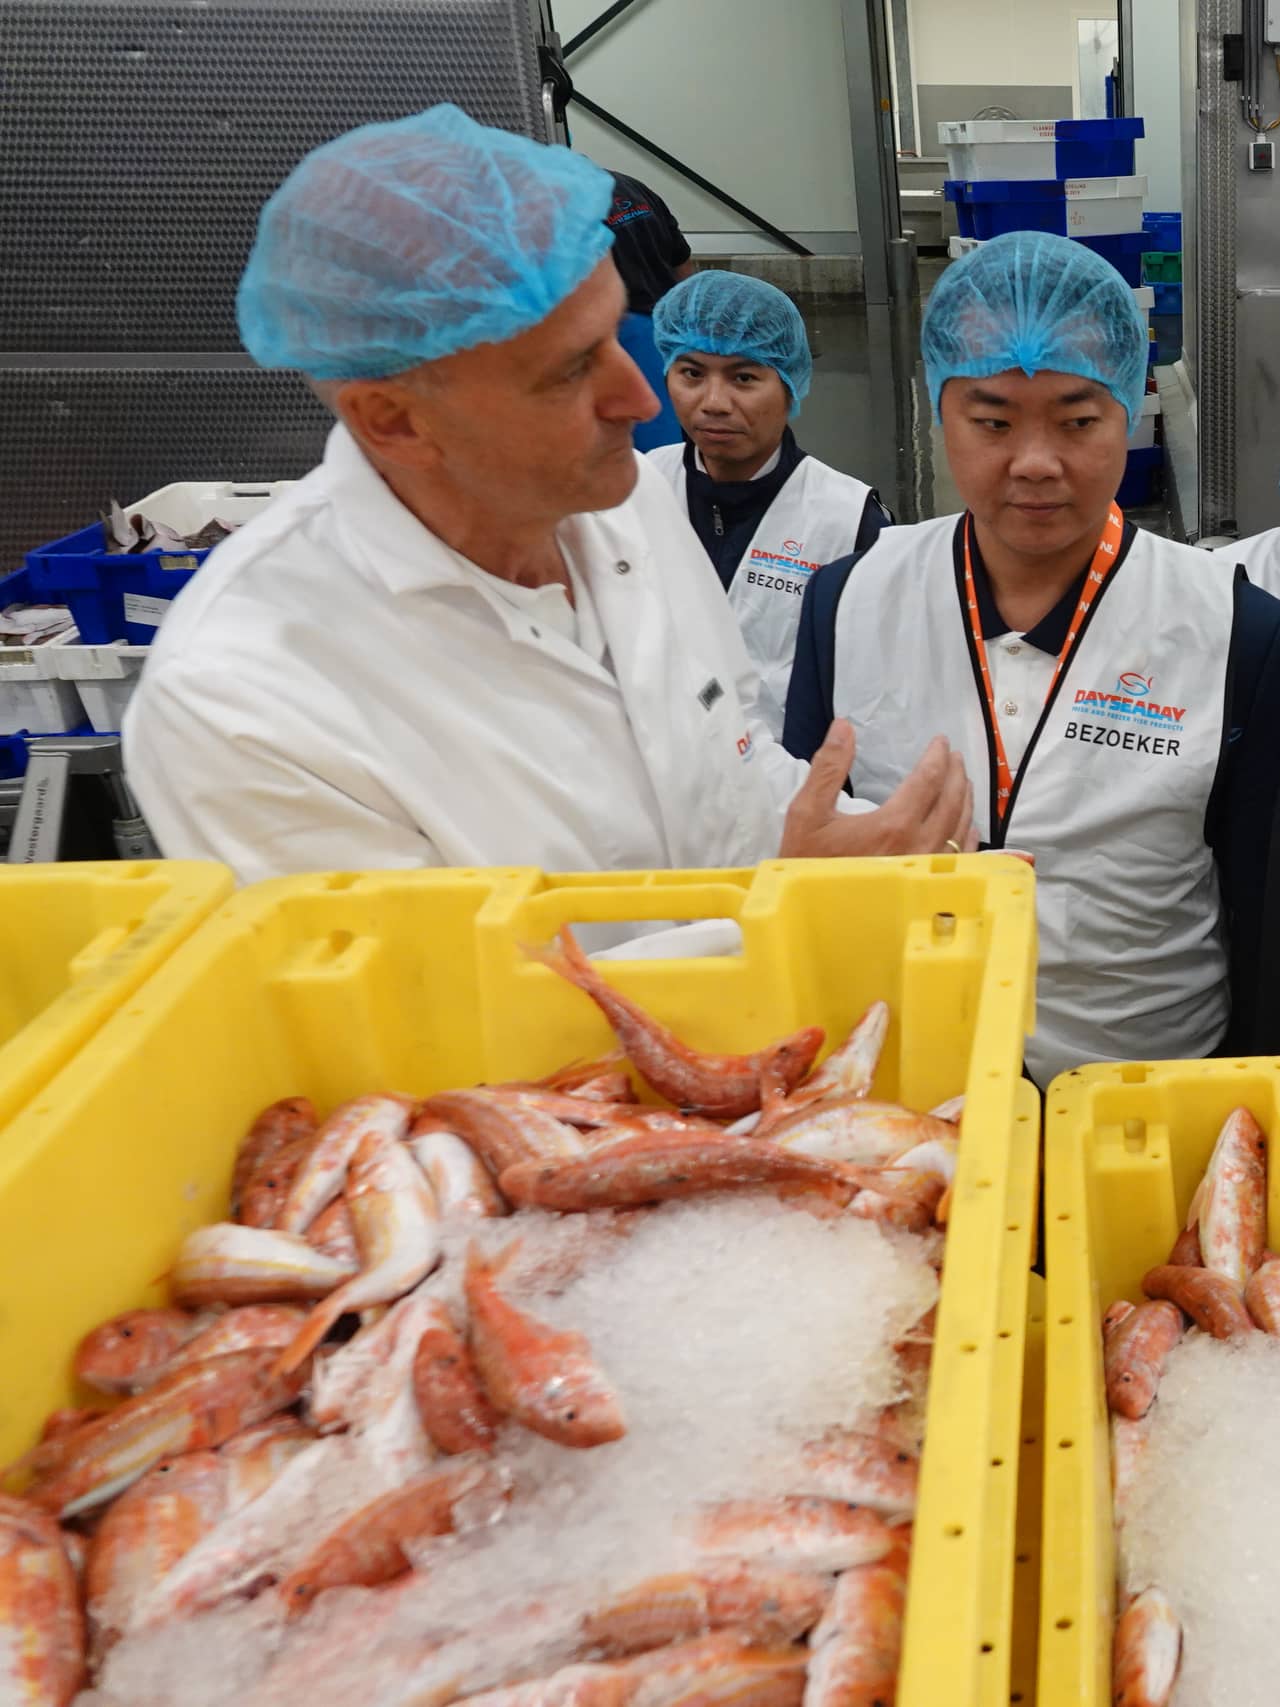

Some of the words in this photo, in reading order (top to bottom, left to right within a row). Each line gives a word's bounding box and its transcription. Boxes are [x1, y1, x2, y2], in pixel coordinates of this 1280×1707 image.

[747, 571, 804, 596] BEZOEK
[1074, 689, 1187, 722] DAYSEADAY
[1064, 722, 1180, 756] BEZOEKER
